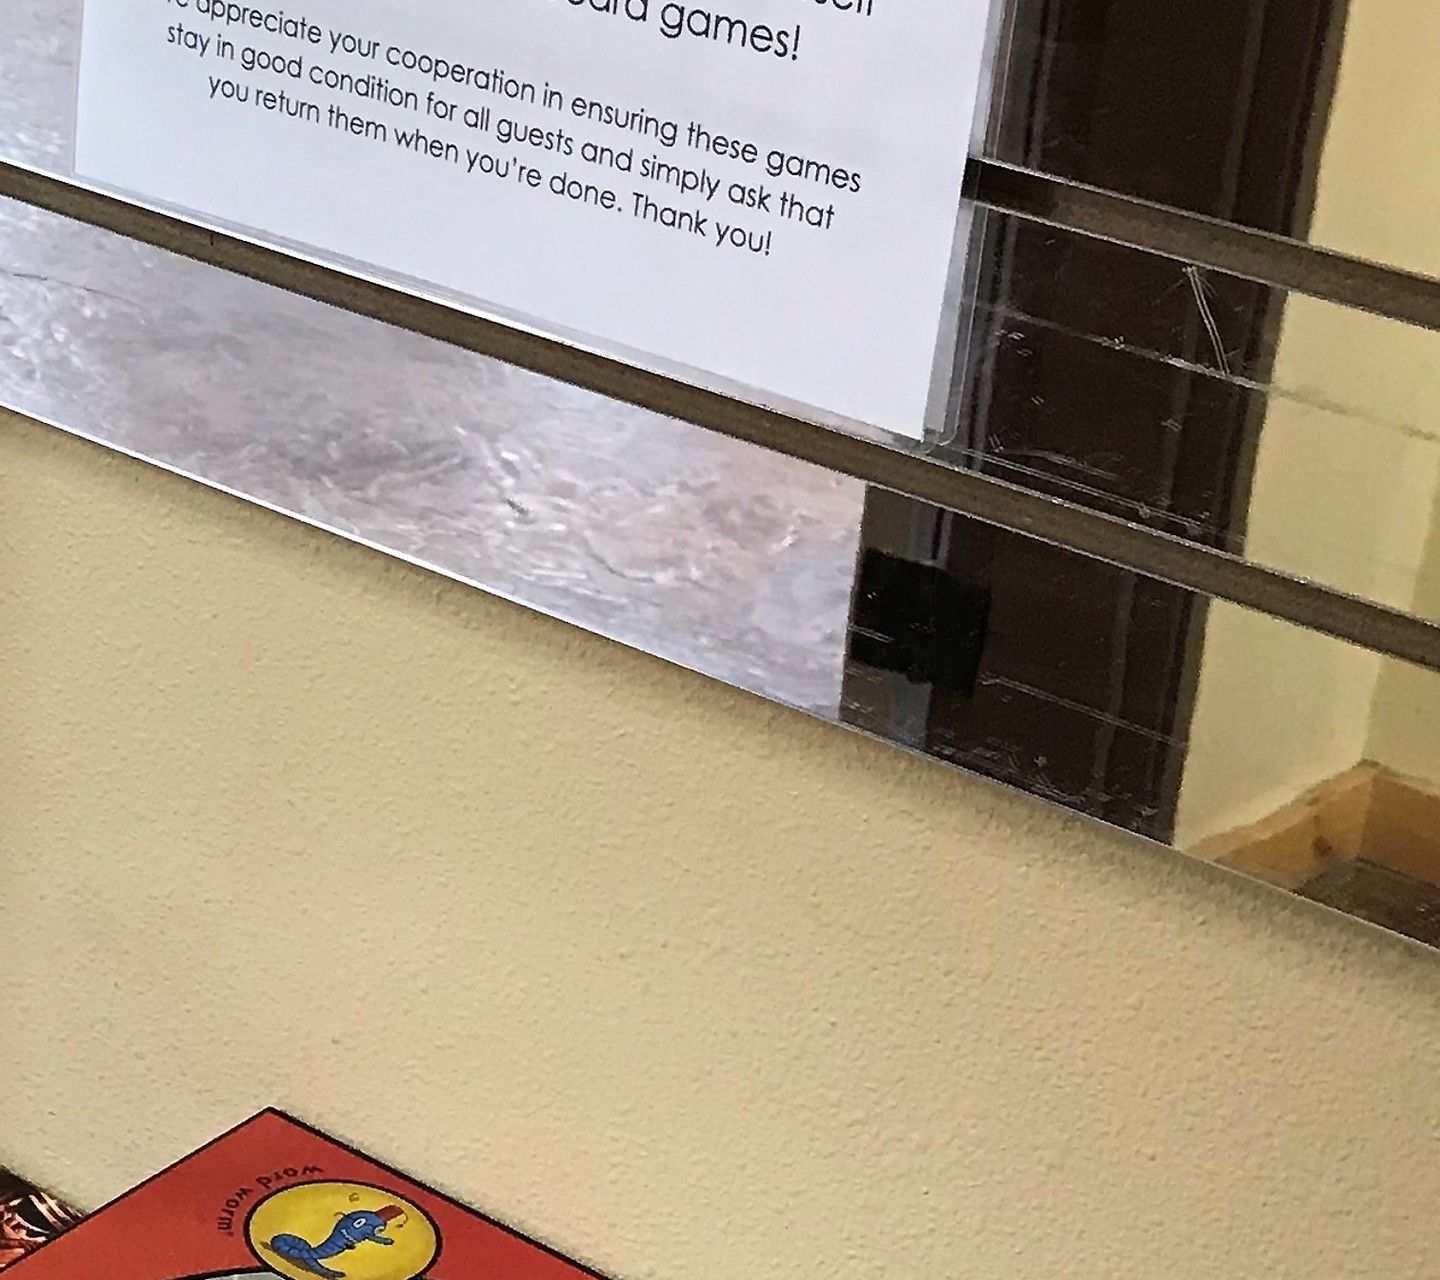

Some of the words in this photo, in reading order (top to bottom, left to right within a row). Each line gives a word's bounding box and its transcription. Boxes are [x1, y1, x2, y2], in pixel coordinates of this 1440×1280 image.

[328, 29, 381, 60] your
[384, 45, 535, 104] cooperation
[541, 81, 563, 111] in
[570, 96, 678, 147] ensuring
[686, 120, 758, 164] these
[764, 149, 861, 193] games
[658, 1, 801, 61] games!
[166, 21, 211, 58] stay
[215, 32, 234, 60] in
[240, 46, 303, 79] good
[308, 64, 418, 111] condition
[425, 90, 458, 122] for
[462, 105, 490, 132] all
[495, 117, 573, 156] guests
[580, 141, 633, 173] and
[639, 153, 721, 201] simply
[727, 182, 771, 213] ask
[778, 190, 835, 230] that
[207, 74, 249, 103] you
[254, 88, 320, 124] return
[326, 103, 387, 142] them
[392, 127, 459, 164] when
[465, 148, 542, 188] you're
[548, 170, 622, 213] done.
[631, 190, 708, 237] Thank
[714, 221, 772, 257] you!
[255, 1165, 325, 1189] word
